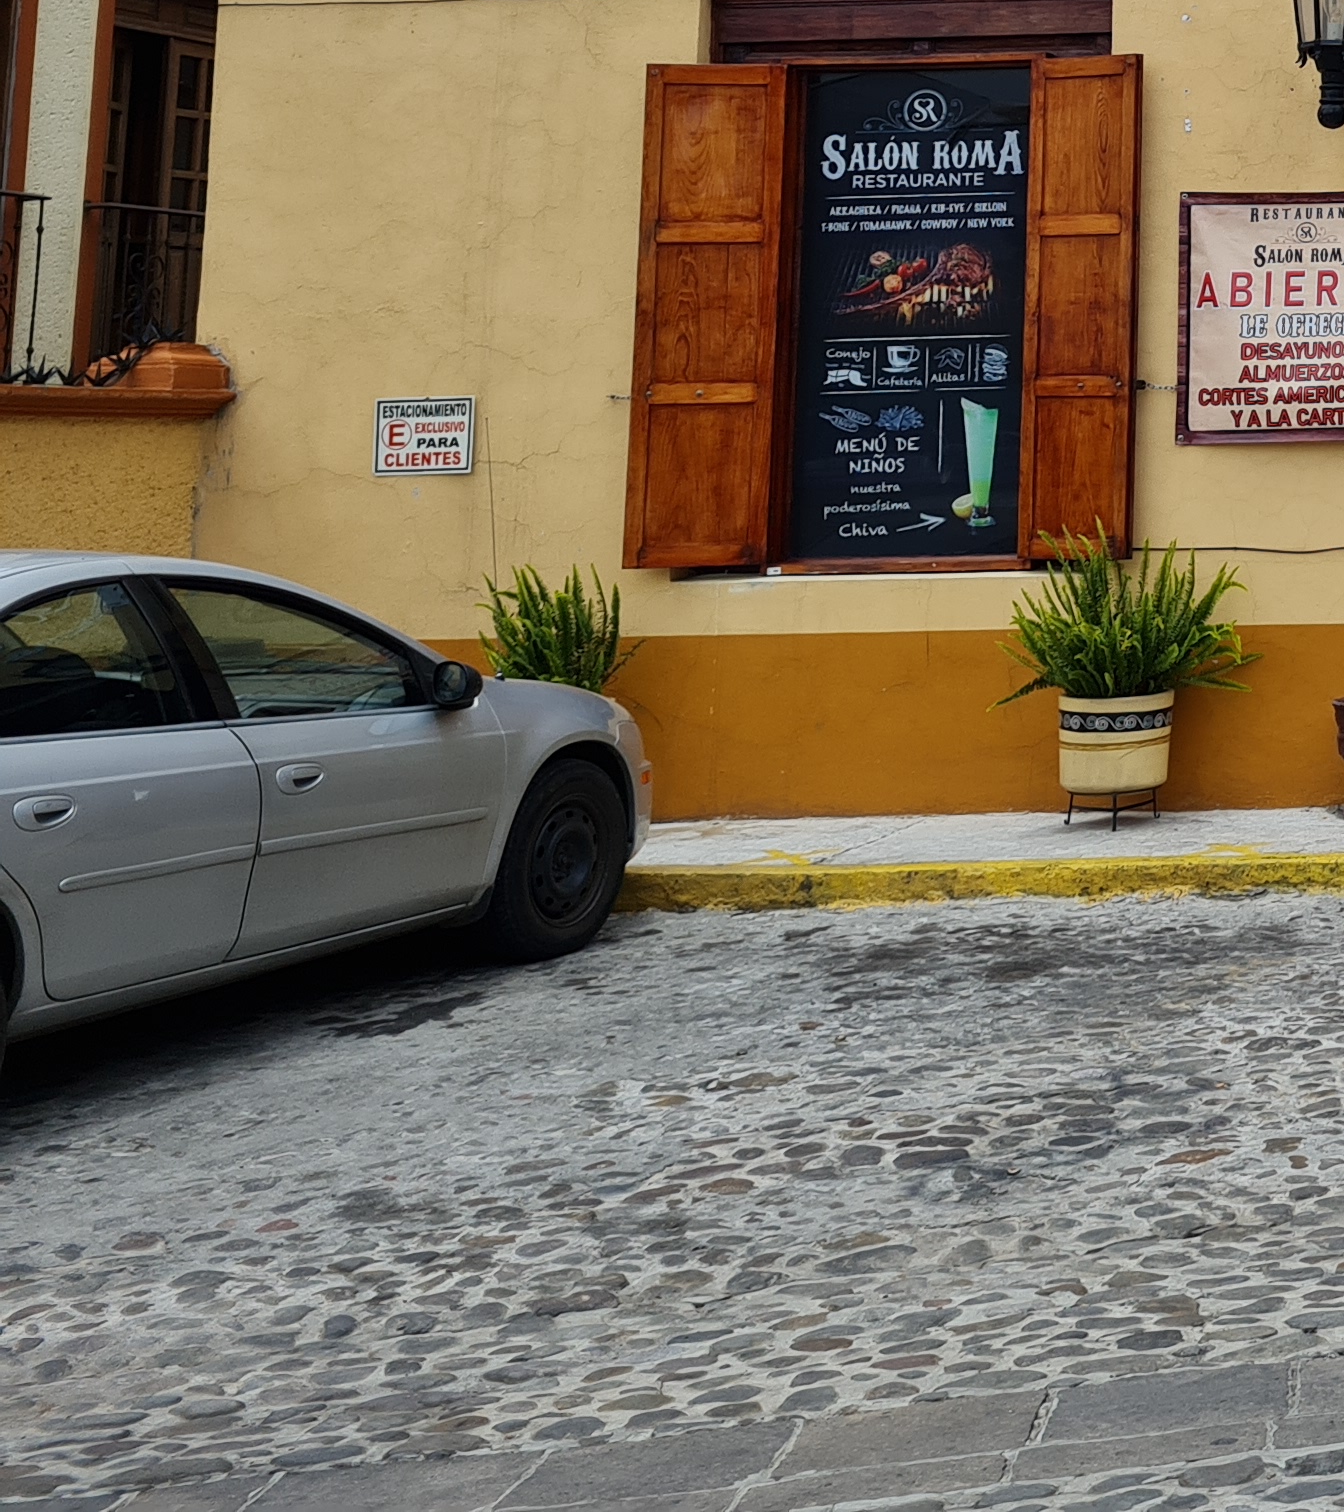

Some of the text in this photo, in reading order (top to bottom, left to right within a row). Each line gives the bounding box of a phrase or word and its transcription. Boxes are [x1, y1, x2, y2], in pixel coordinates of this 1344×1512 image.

[932, 129, 1025, 176] ROMA
[852, 172, 985, 189] RESTAURANTE
[829, 205, 882, 216] ARRACHERA
[931, 203, 965, 214] RIB-EYE
[974, 201, 1007, 212] SIRLOIN
[821, 222, 850, 232] T-BONE
[859, 220, 913, 231] TOMAHAWK
[921, 219, 958, 230] COWBOY
[967, 218, 988, 228] NEW
[990, 217, 1014, 228] YORK
[1239, 314, 1268, 338] LE
[826, 347, 871, 362] Conejo
[877, 376, 923, 387] Cafetería
[930, 373, 966, 383] Alitas
[1198, 387, 1268, 406] CORTES
[382, 403, 467, 419] ESTACIONAMIENTO
[1231, 410, 1243, 427] Y
[1247, 409, 1261, 427] A
[1266, 409, 1292, 427] LA
[389, 423, 406, 447] E
[414, 421, 465, 434] EXCLUSIVO
[416, 437, 459, 449] PARA
[835, 432, 920, 454] MENÚ DE
[384, 451, 461, 467] CLIENTES
[849, 453, 905, 474] NIÑOS
[850, 481, 901, 493] nuestra
[838, 522, 888, 537] Chiva
